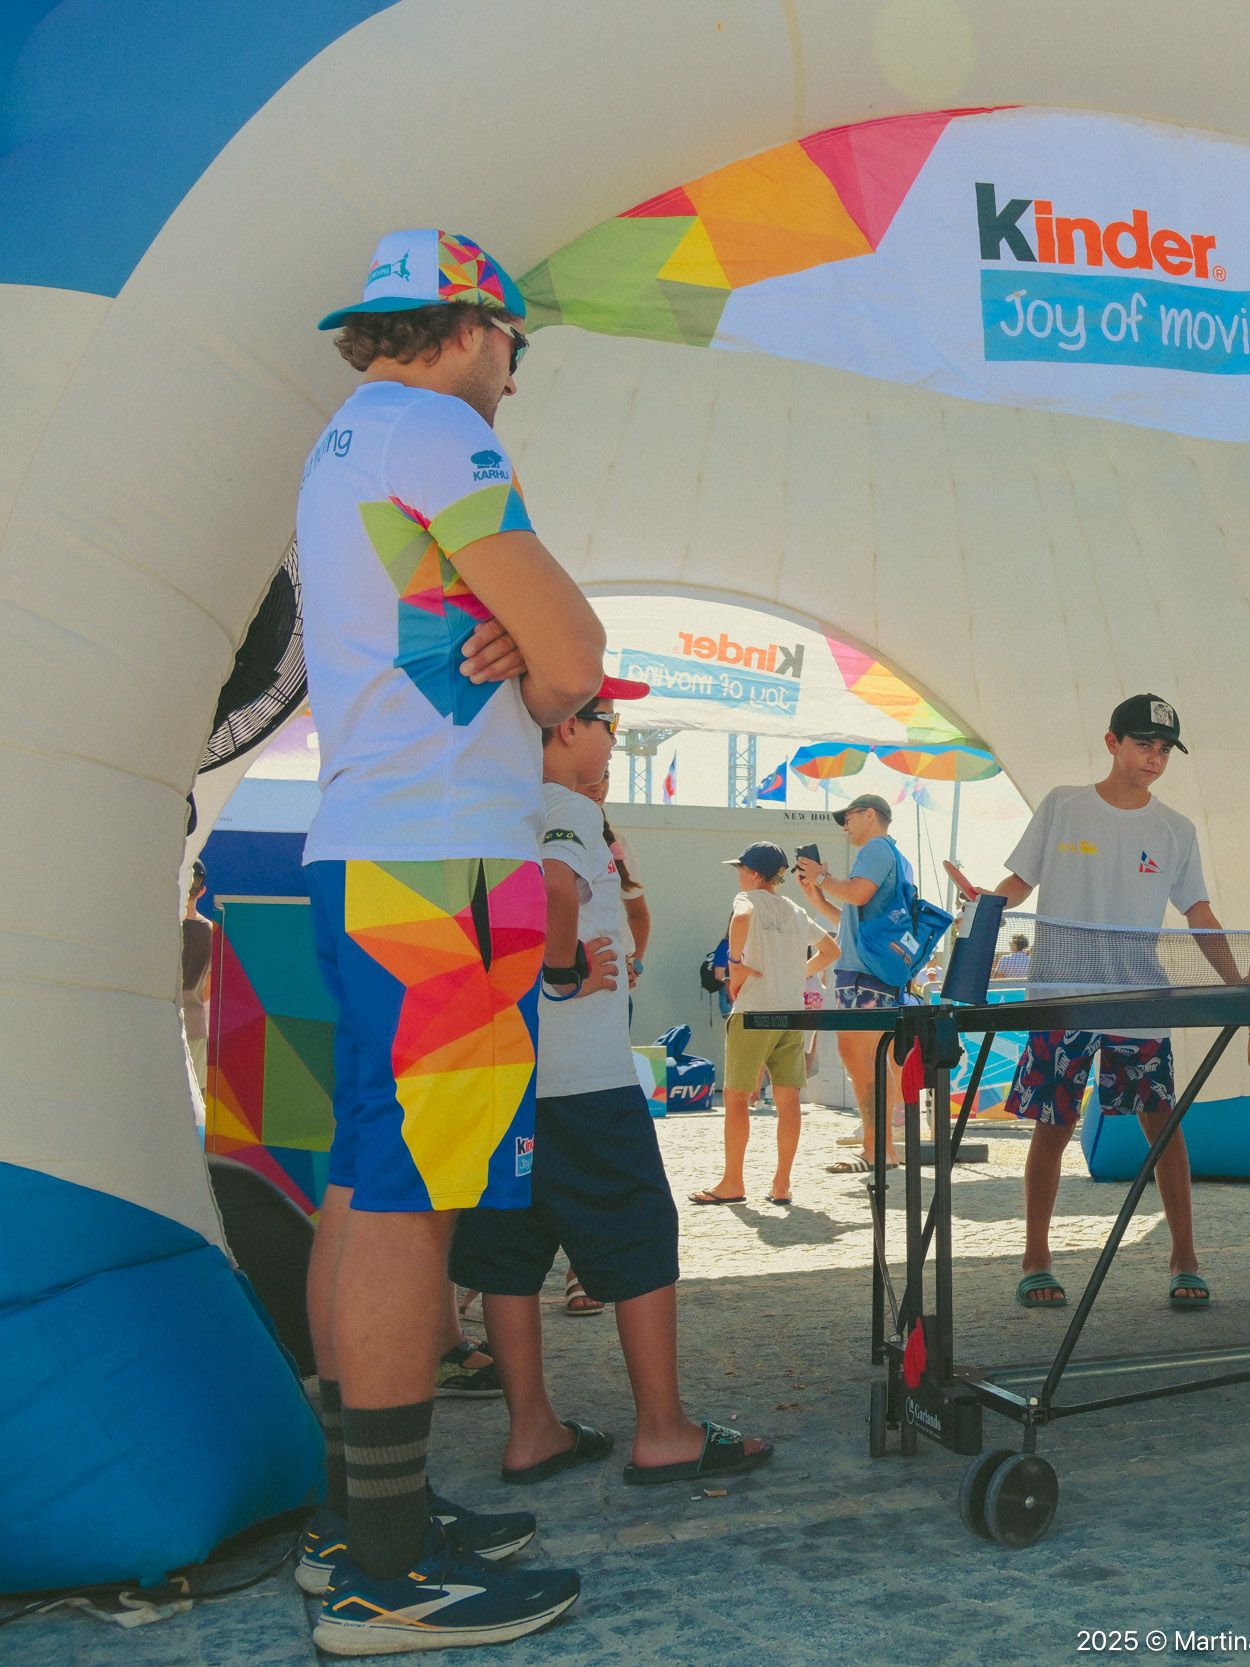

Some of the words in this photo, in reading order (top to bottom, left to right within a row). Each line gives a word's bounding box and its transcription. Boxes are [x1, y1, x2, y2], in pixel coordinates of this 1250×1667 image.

[975, 182, 1216, 280] Kinder
[999, 289, 1085, 350] Joy
[1100, 292, 1147, 343] of
[473, 470, 509, 481] KARHU
[1057, 1053, 1070, 1077] NIKE
[669, 1085, 701, 1098] FIV
[915, 1403, 942, 1431] Garlando
